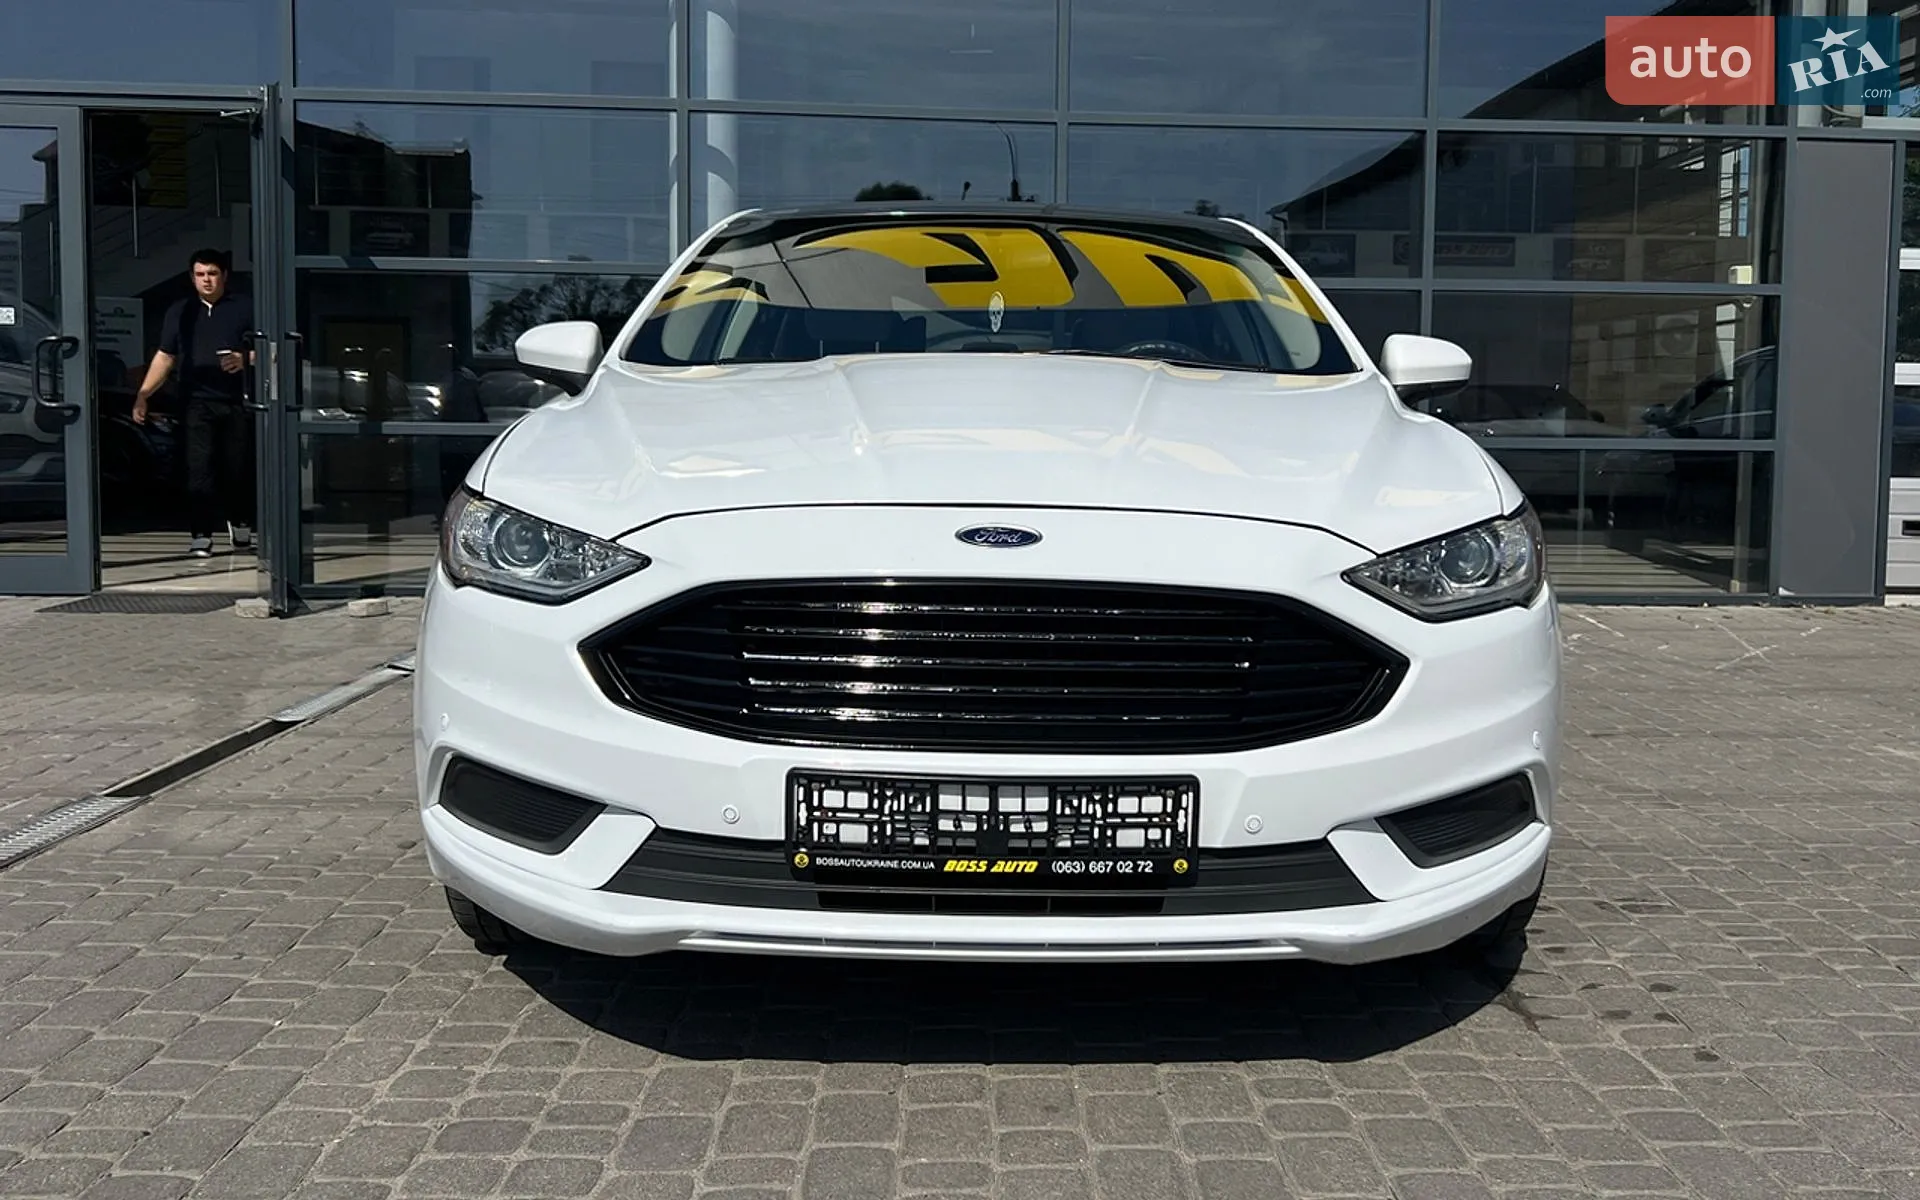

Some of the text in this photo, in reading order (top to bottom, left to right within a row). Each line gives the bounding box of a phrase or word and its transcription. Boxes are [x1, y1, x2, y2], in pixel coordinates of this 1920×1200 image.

[974, 528, 1022, 543] Ford
[815, 857, 936, 870] BOSSAUTOUKRAINE.COM.UA
[943, 860, 1039, 873] BOSS AUTO
[1051, 860, 1154, 874] (063) 667 02 72
